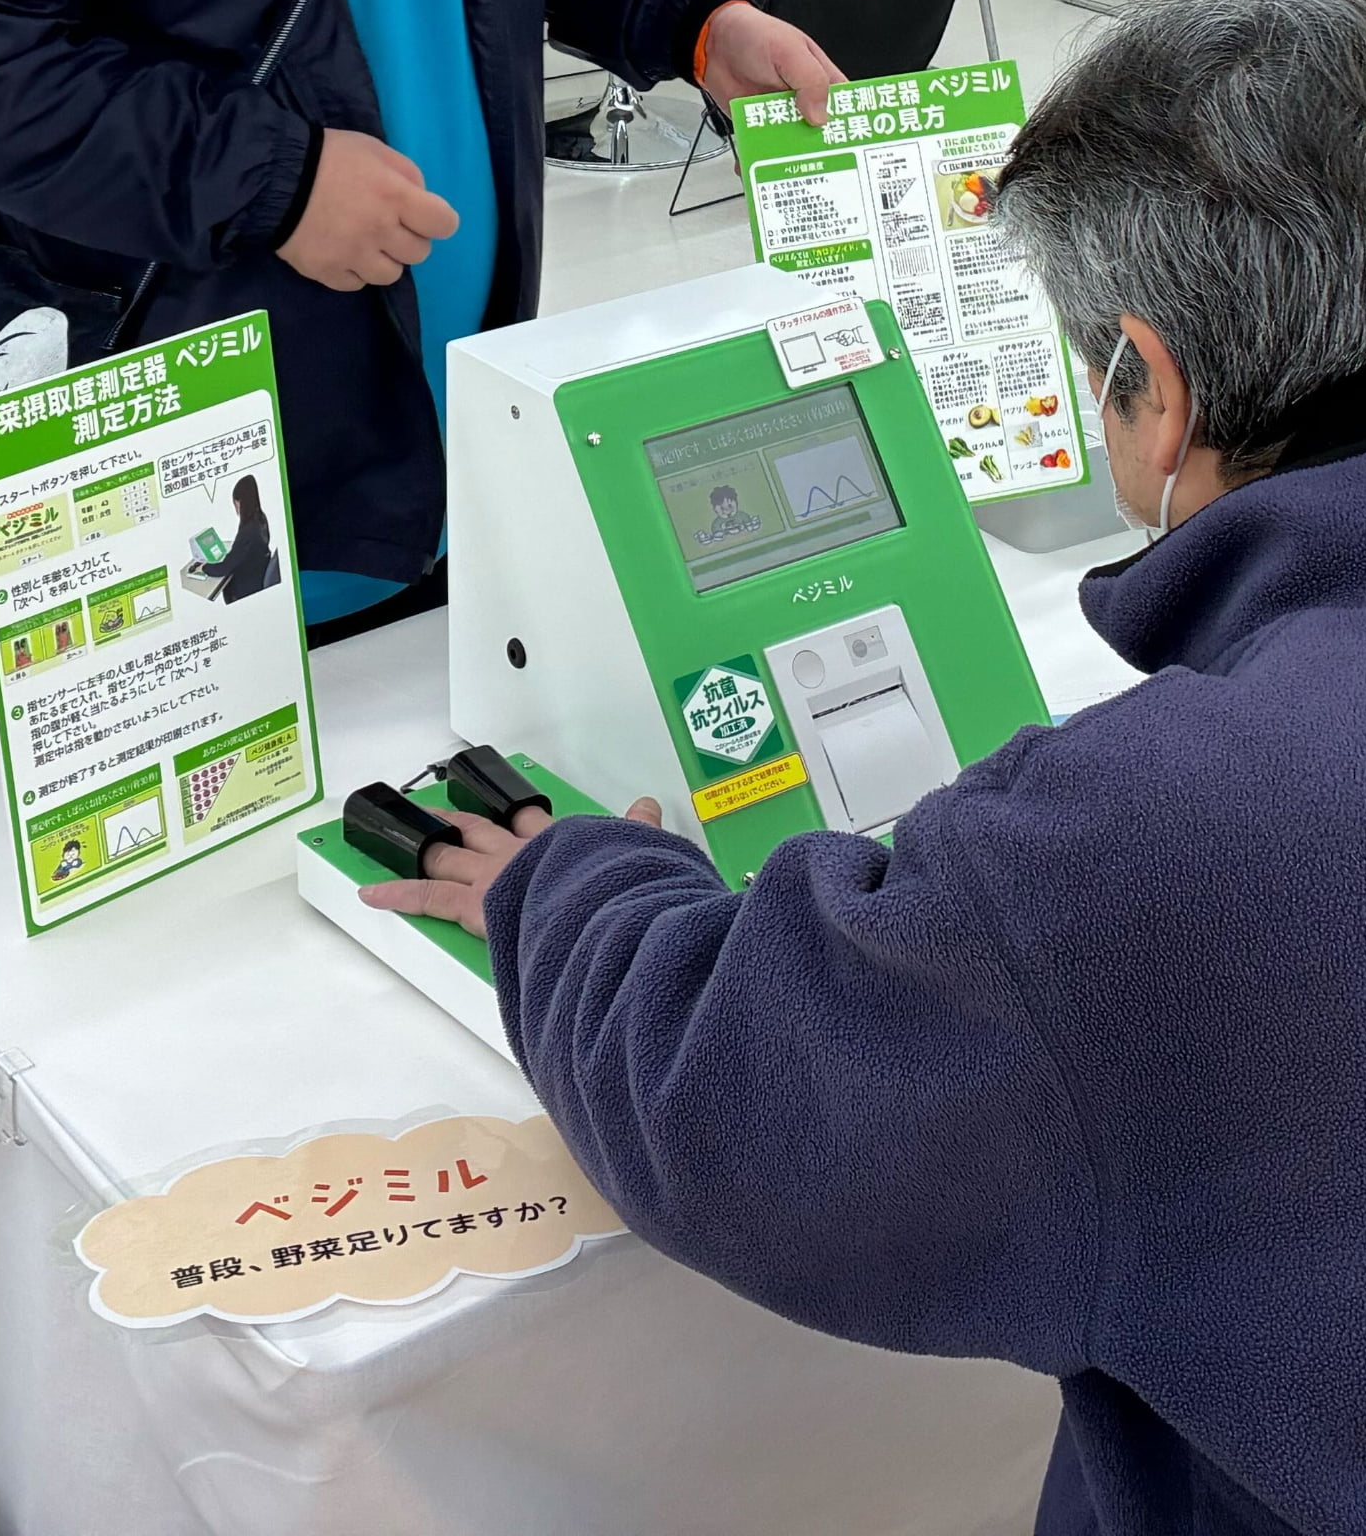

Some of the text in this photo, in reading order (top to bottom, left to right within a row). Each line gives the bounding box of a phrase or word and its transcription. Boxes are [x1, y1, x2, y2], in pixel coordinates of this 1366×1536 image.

[929, 67, 1010, 98] ベジミル
[823, 104, 945, 145] 結果の見方
[175, 323, 262, 368] ベジミル
[73, 383, 182, 446] 測定方法
[10, 549, 111, 599] 性別と年齢を入力して
[792, 575, 853, 603] ベジミル
[688, 686, 765, 732] 抗ウィルス
[700, 674, 739, 704] 抗菌
[32, 717, 97, 755] 押して下さい。
[235, 1159, 488, 1225] ベジミル
[169, 1195, 569, 1290] 普段、野菜足りてますか？
